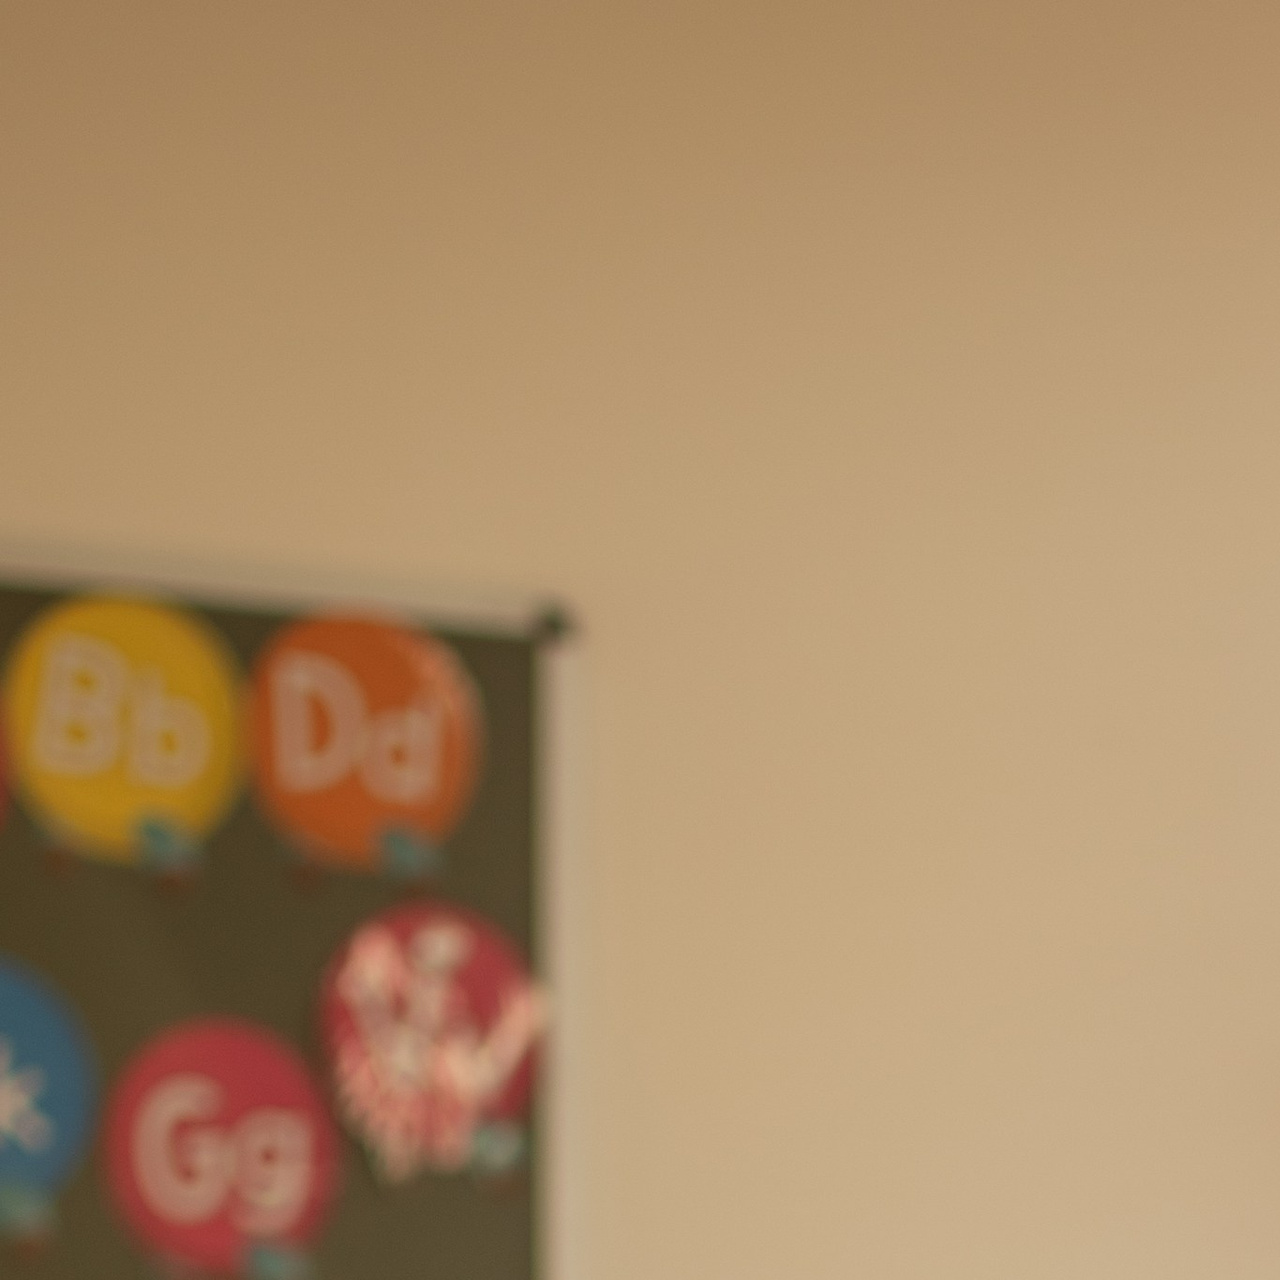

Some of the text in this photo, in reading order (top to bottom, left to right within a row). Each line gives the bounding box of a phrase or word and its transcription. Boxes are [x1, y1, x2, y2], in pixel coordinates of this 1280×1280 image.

[32, 632, 212, 792] Bb
[268, 650, 455, 805] Dd
[131, 1073, 314, 1236] Gg
